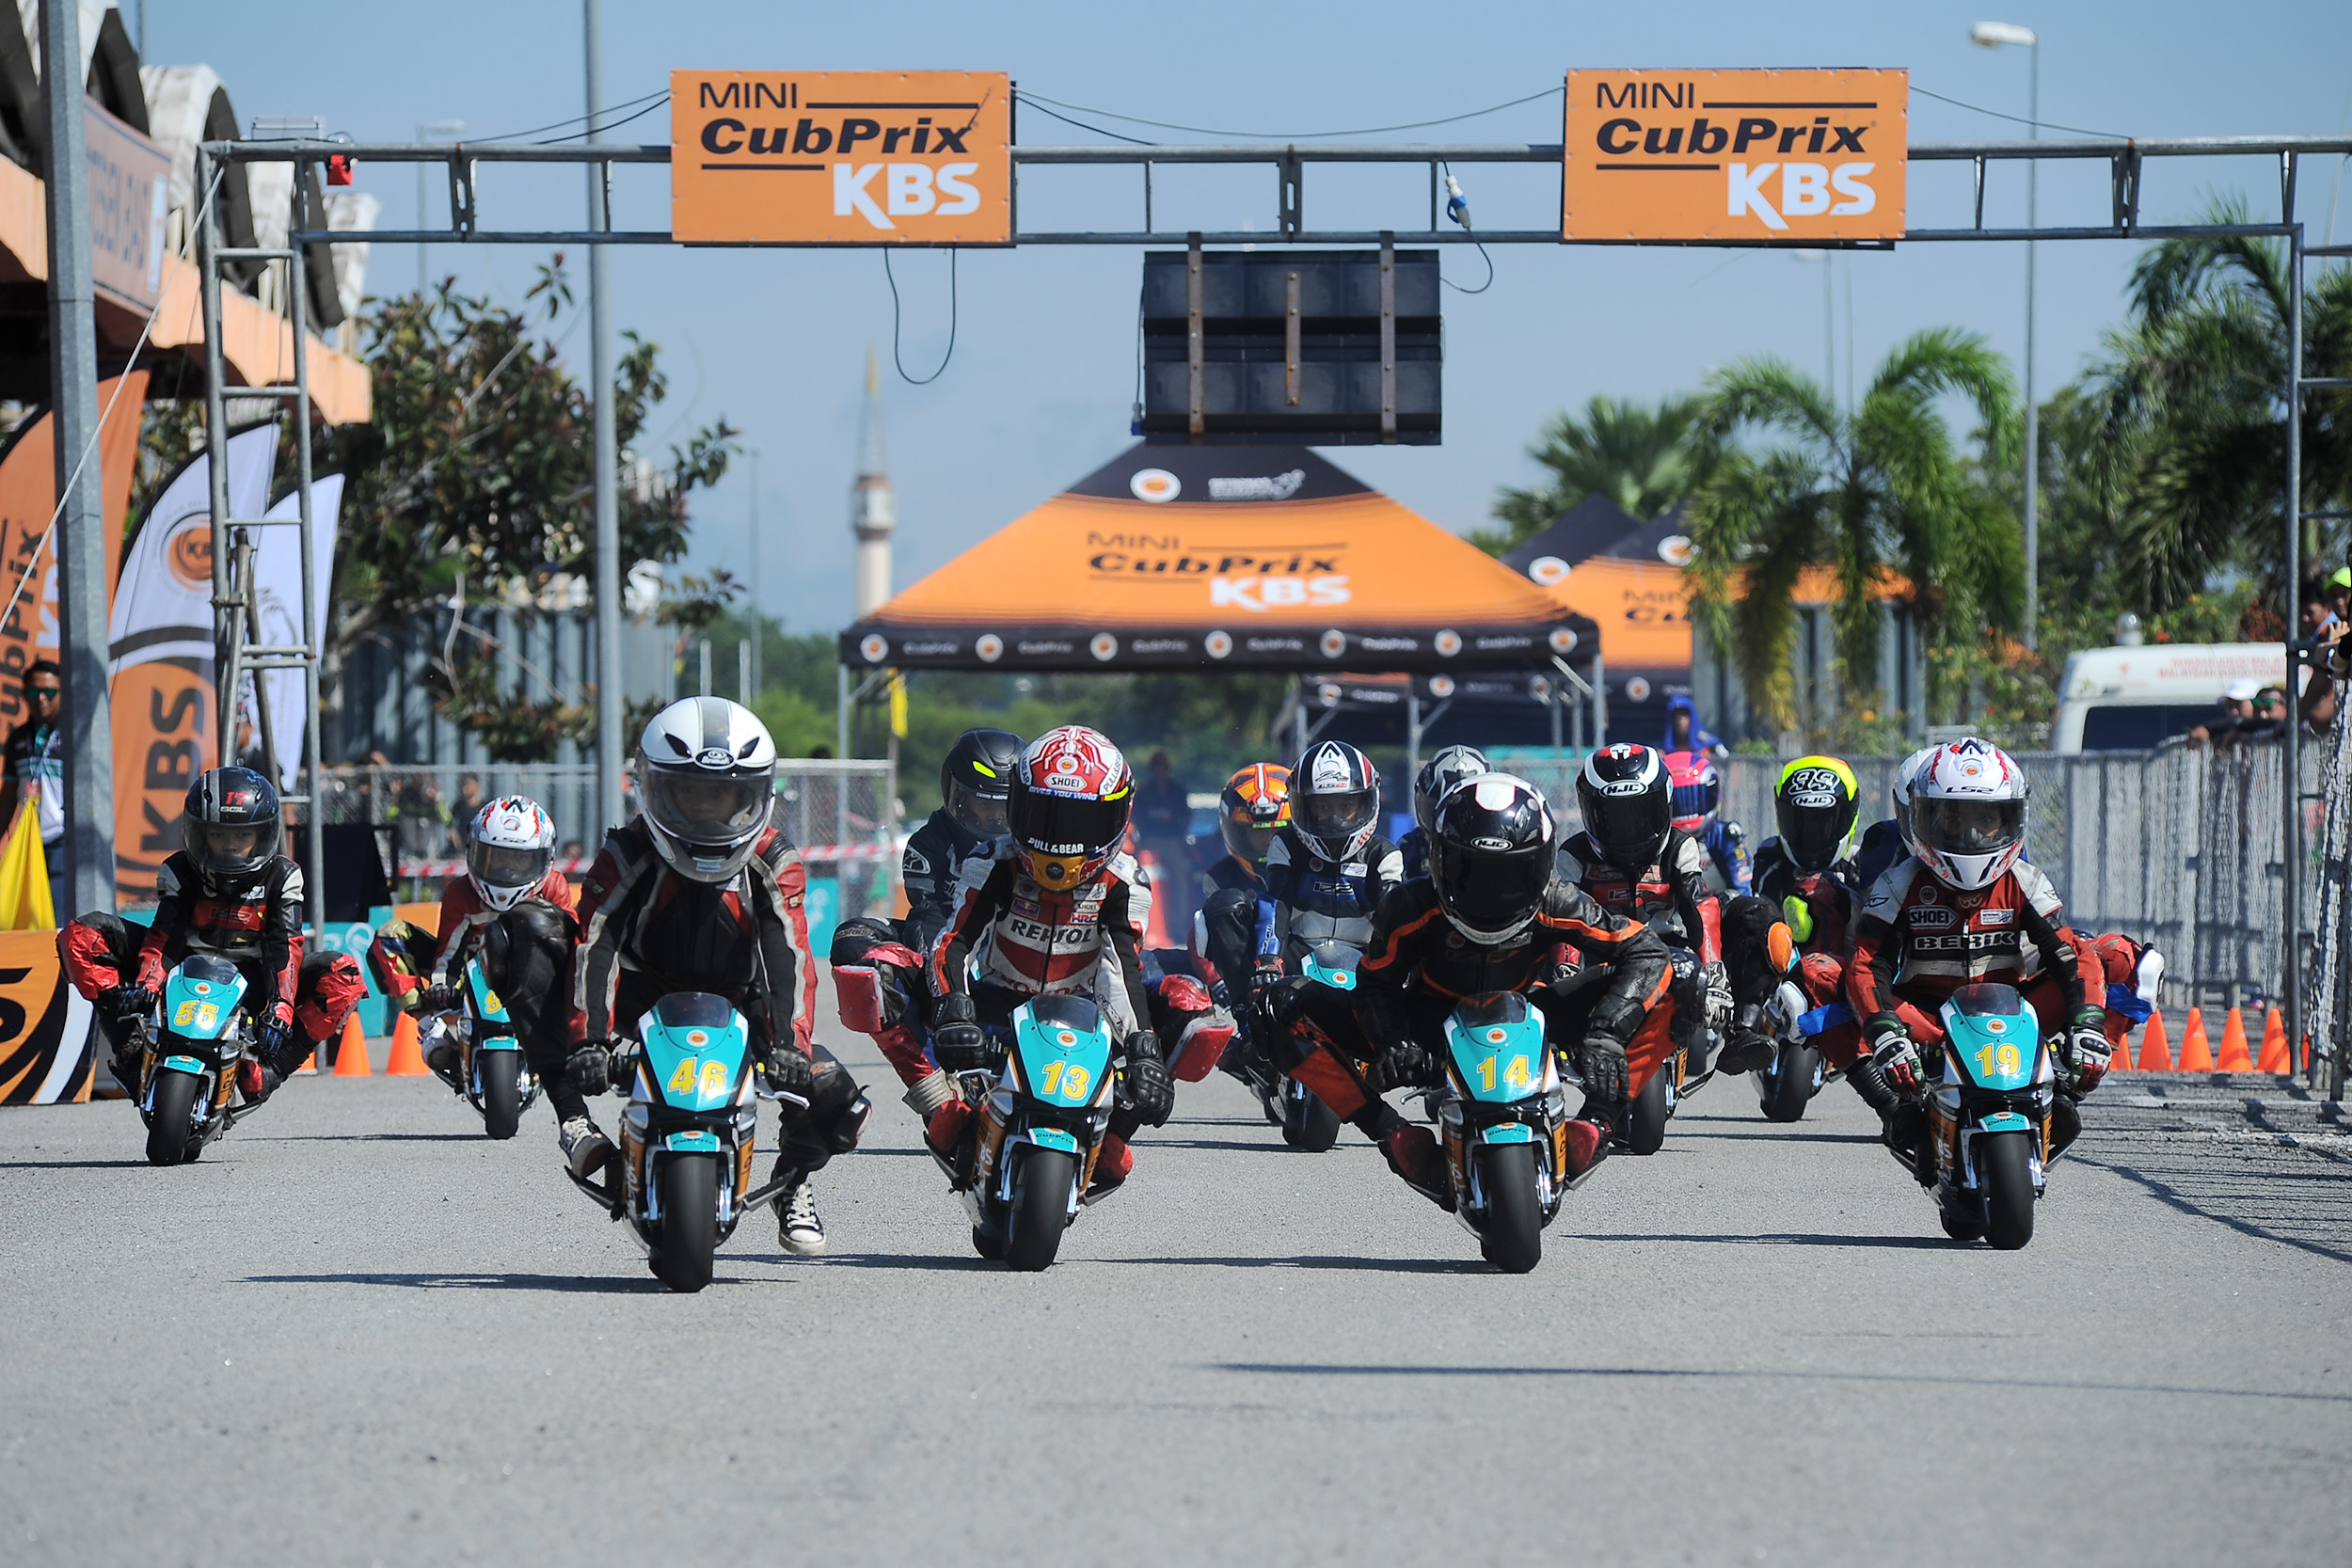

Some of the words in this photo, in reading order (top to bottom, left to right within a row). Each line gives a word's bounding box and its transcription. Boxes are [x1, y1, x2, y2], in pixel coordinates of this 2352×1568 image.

[700, 83, 797, 108] MINI
[1597, 83, 1694, 108] MINI
[701, 118, 970, 153] CubPrix
[1597, 117, 1868, 153] CubPrix
[833, 163, 981, 230] KBS
[1727, 163, 1877, 230] KBS
[1088, 531, 1180, 550] MINI
[1090, 551, 1338, 573] CubPrix
[1210, 575, 1353, 611] KBS
[140, 688, 205, 852] KBS
[1051, 777, 1080, 787] SHOEI
[226, 791, 249, 805] 17
[1946, 786, 1995, 795] LS2
[1072, 914, 1098, 924] HRC
[1910, 911, 1949, 924] SHOEI
[174, 1000, 219, 1031] 55
[1477, 1054, 1532, 1092] 14
[1975, 1042, 2023, 1079] 19
[667, 1056, 727, 1099] 46
[1041, 1059, 1090, 1101] 13
